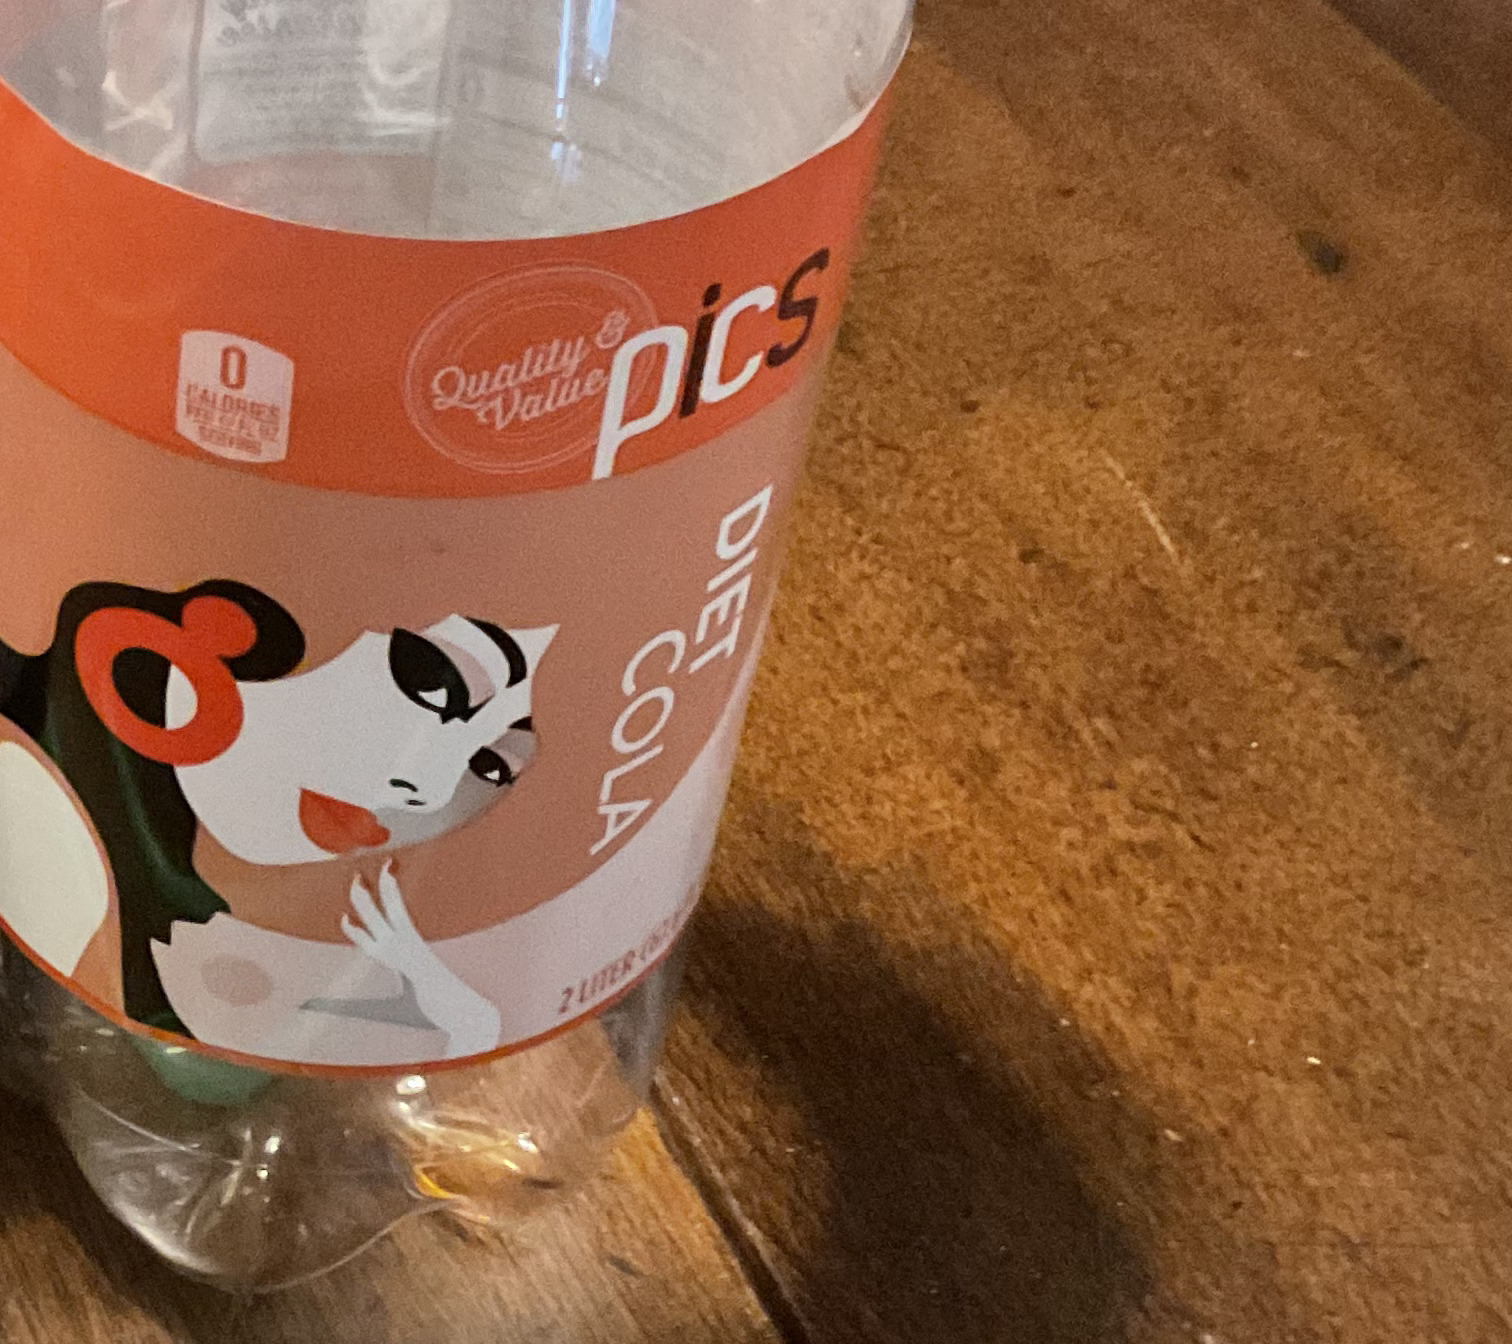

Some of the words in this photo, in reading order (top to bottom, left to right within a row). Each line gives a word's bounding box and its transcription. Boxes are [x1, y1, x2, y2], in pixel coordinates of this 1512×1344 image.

[220, 345, 248, 390] 0
[432, 335, 586, 411] Quality
[478, 367, 608, 430] Value
[593, 249, 829, 480] pics
[689, 484, 773, 674] DIET
[588, 629, 687, 856] COLA
[557, 985, 575, 1016] 2
[577, 948, 637, 1005] LITER
